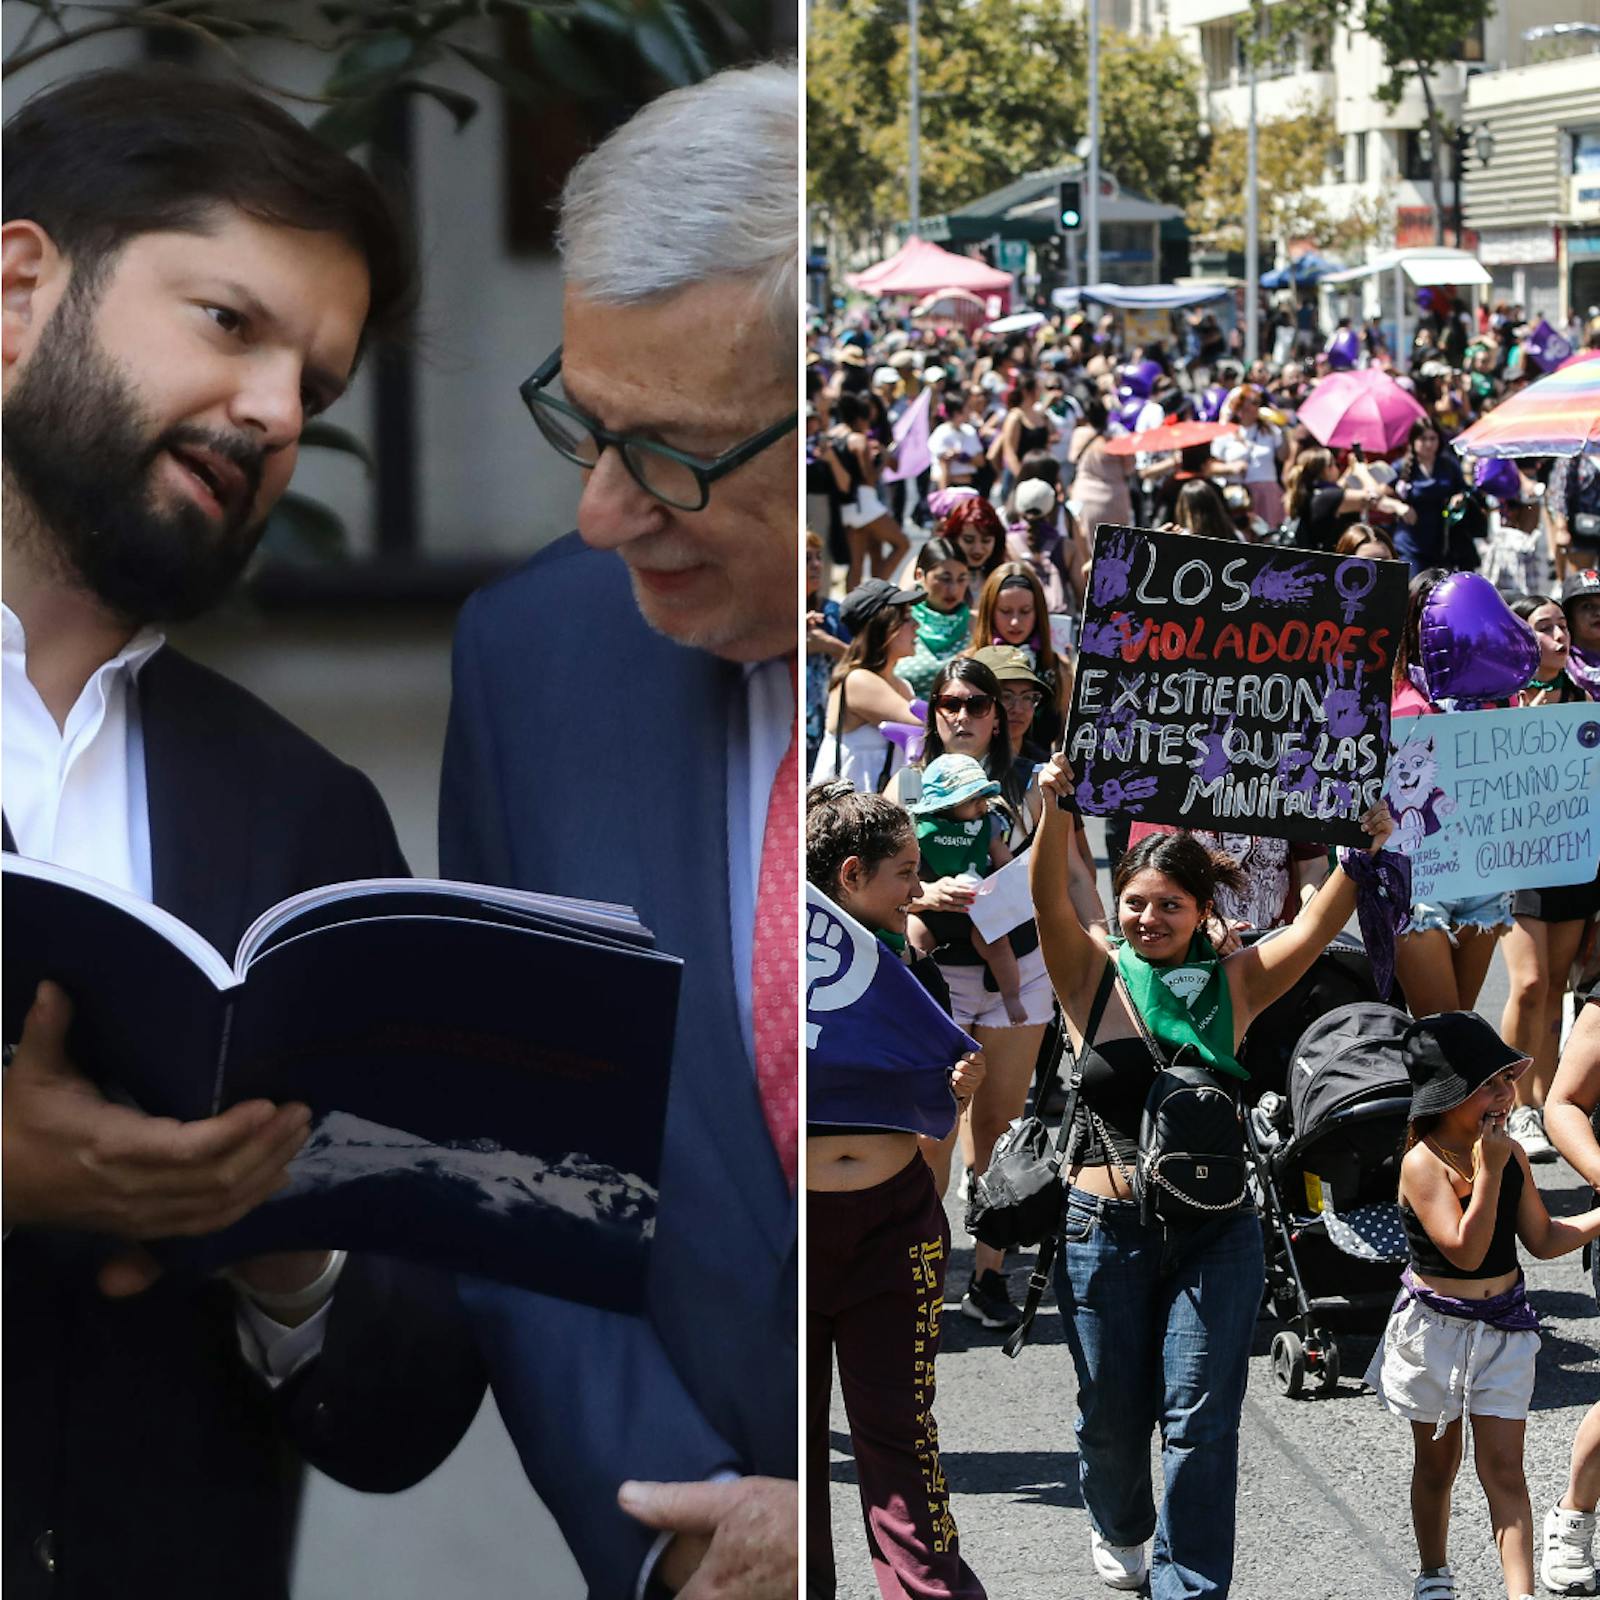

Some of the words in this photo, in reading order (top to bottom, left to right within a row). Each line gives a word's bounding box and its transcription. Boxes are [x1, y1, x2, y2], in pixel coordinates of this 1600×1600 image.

[1136, 543, 1250, 612] LOS
[1068, 719, 1210, 769] ANTES
[1221, 722, 1302, 770] QUE
[1312, 733, 1378, 776] LAS
[1455, 728, 1490, 769] EL
[1564, 756, 1594, 792] SE
[1501, 806, 1523, 832] EN
[908, 1244, 928, 1425] UNIVERSITY
